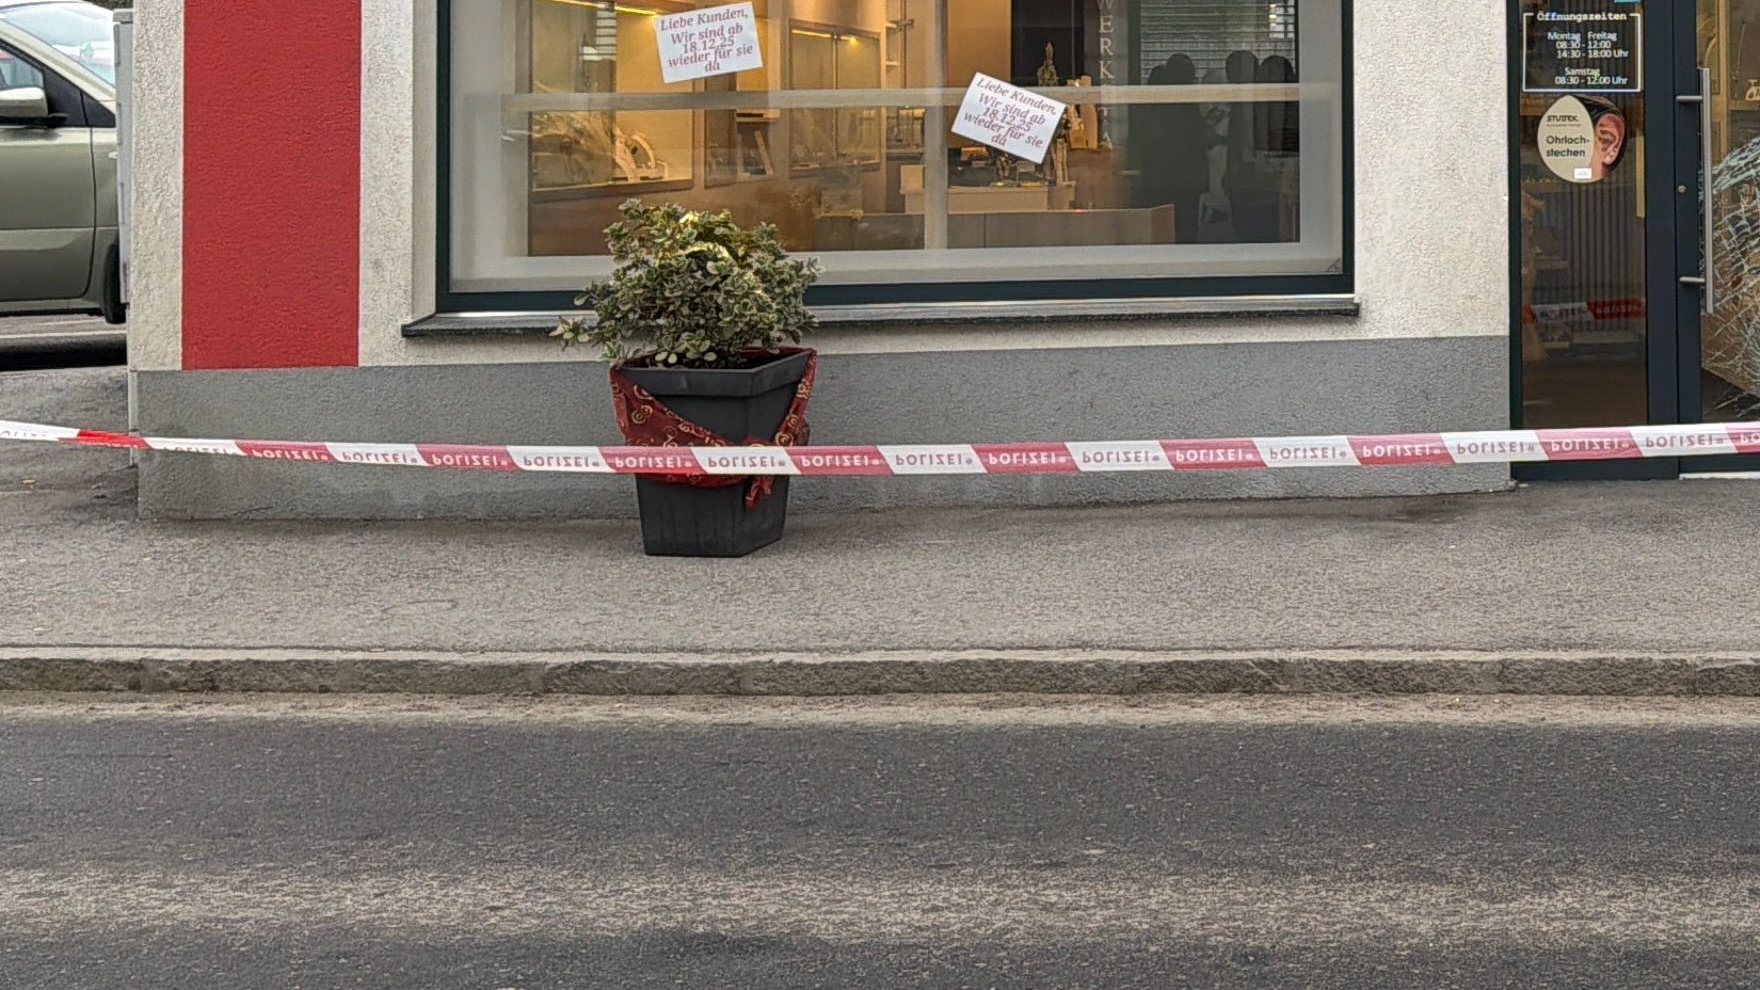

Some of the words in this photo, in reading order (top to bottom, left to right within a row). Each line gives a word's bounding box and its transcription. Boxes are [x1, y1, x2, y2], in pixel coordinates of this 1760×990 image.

[1537, 11, 1627, 23] Öffnungszeiten
[661, 17, 693, 31] Liebe
[671, 31, 695, 44] Wir
[699, 26, 724, 39] sind
[728, 23, 743, 34] ab
[1547, 32, 1581, 42] Montag
[1588, 32, 1618, 42] Freitag
[1556, 41, 1580, 49] 08:30
[1587, 41, 1611, 49] 12:00
[669, 51, 710, 67] wieder
[737, 44, 753, 55] sie
[1557, 50, 1581, 58] 14:30
[1613, 50, 1629, 58] Uhr
[705, 61, 720, 72] da
[1564, 67, 1600, 78] Samstag
[1587, 76, 1610, 84] 12:00
[1612, 76, 1628, 84] Uhr
[977, 78, 1009, 96] Liebe
[979, 93, 1002, 107] Wir
[1003, 104, 1029, 119] sind
[1031, 113, 1046, 125] ab
[964, 113, 1006, 132] wieder
[1025, 136, 1043, 147] sie
[991, 134, 1006, 146] da
[1546, 135, 1590, 144] Ohrloch-
[1546, 148, 1585, 157] stechen
